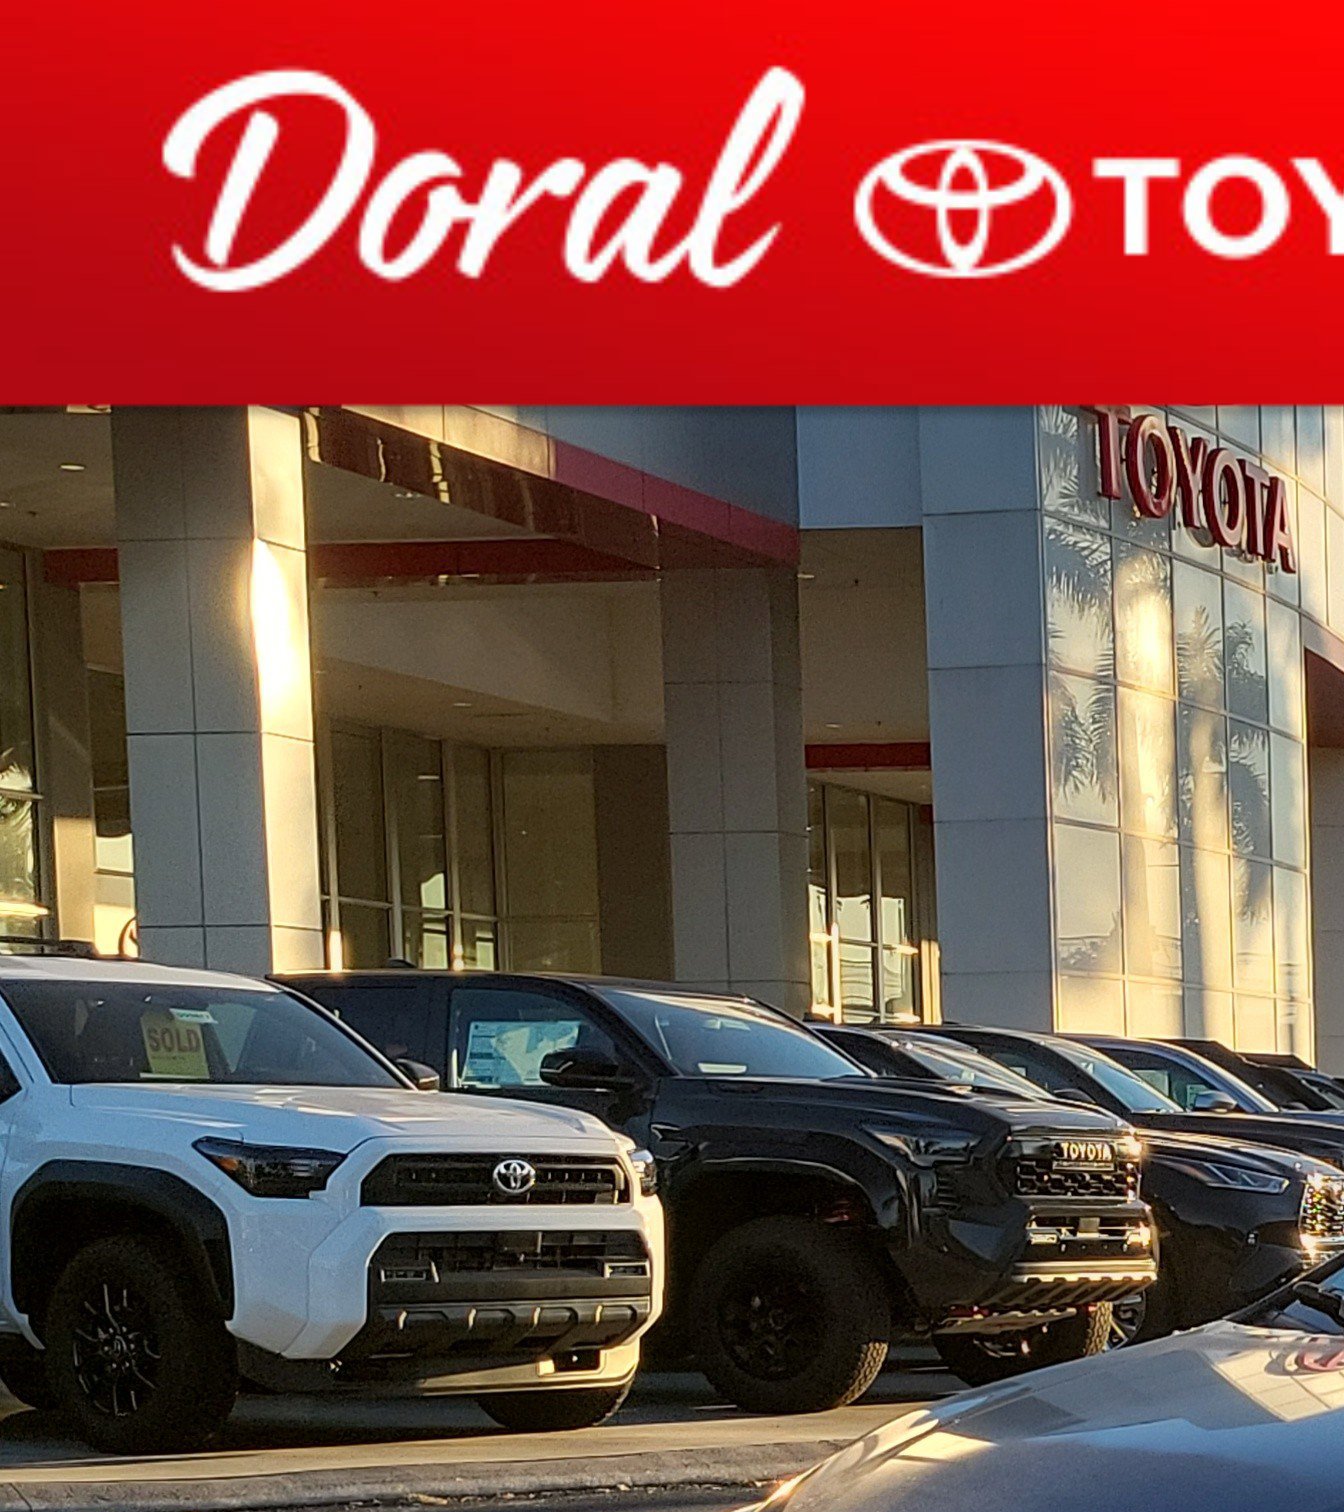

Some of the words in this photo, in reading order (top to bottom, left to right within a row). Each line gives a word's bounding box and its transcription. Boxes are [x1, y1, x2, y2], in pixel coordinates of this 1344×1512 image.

[1082, 405, 1297, 574] TOYOTA
[148, 1027, 200, 1053] SOLD
[1061, 1141, 1113, 1161] TOYOTA
